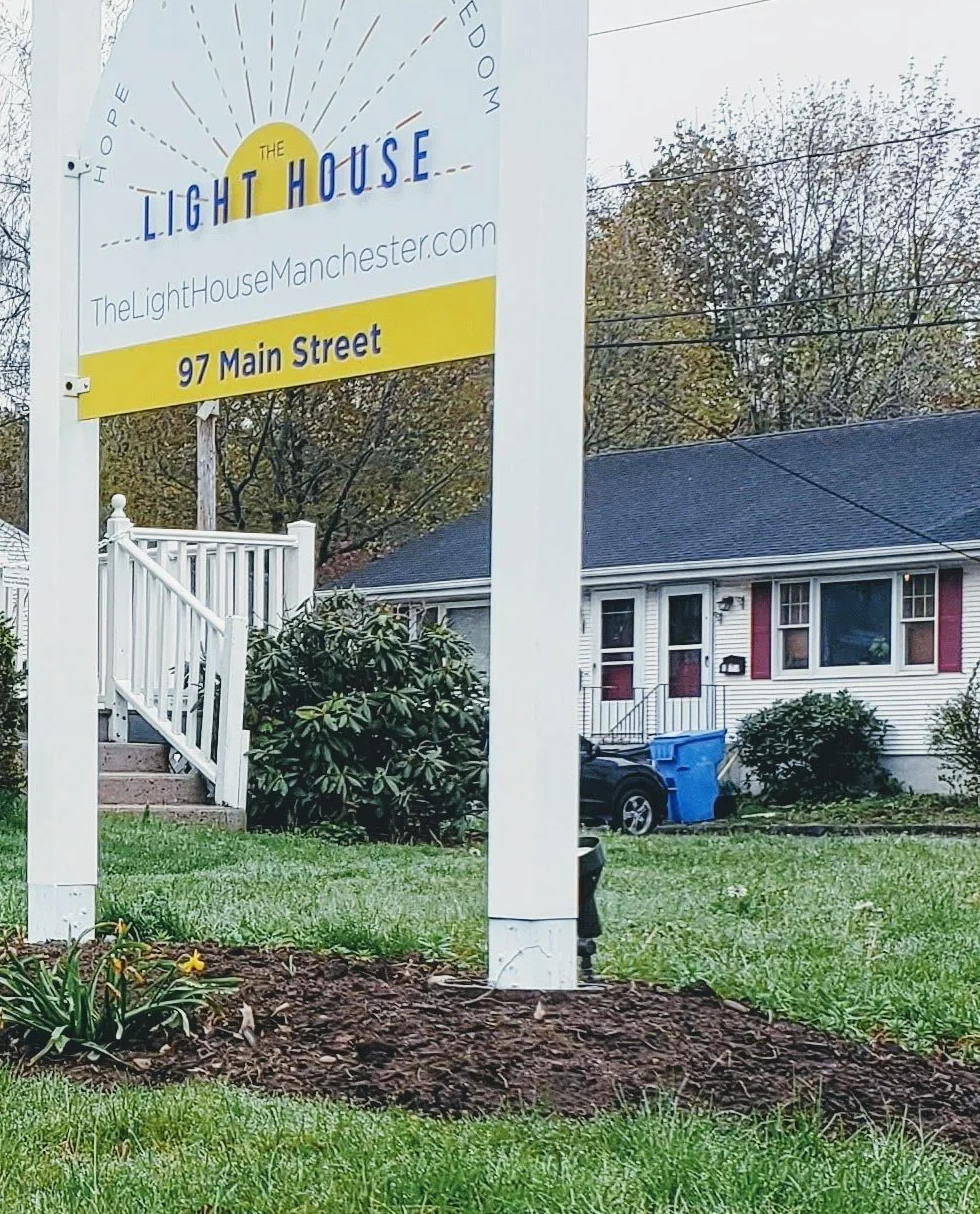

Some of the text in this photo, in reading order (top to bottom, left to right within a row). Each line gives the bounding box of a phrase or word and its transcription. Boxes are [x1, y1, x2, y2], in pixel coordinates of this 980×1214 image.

[93, 81, 129, 184] HOPE
[259, 140, 285, 161] THE
[143, 129, 430, 242] LIGHT HOUSE
[91, 220, 497, 327] TheLightHouseManchester.com
[178, 323, 381, 388] 97 Main Street
